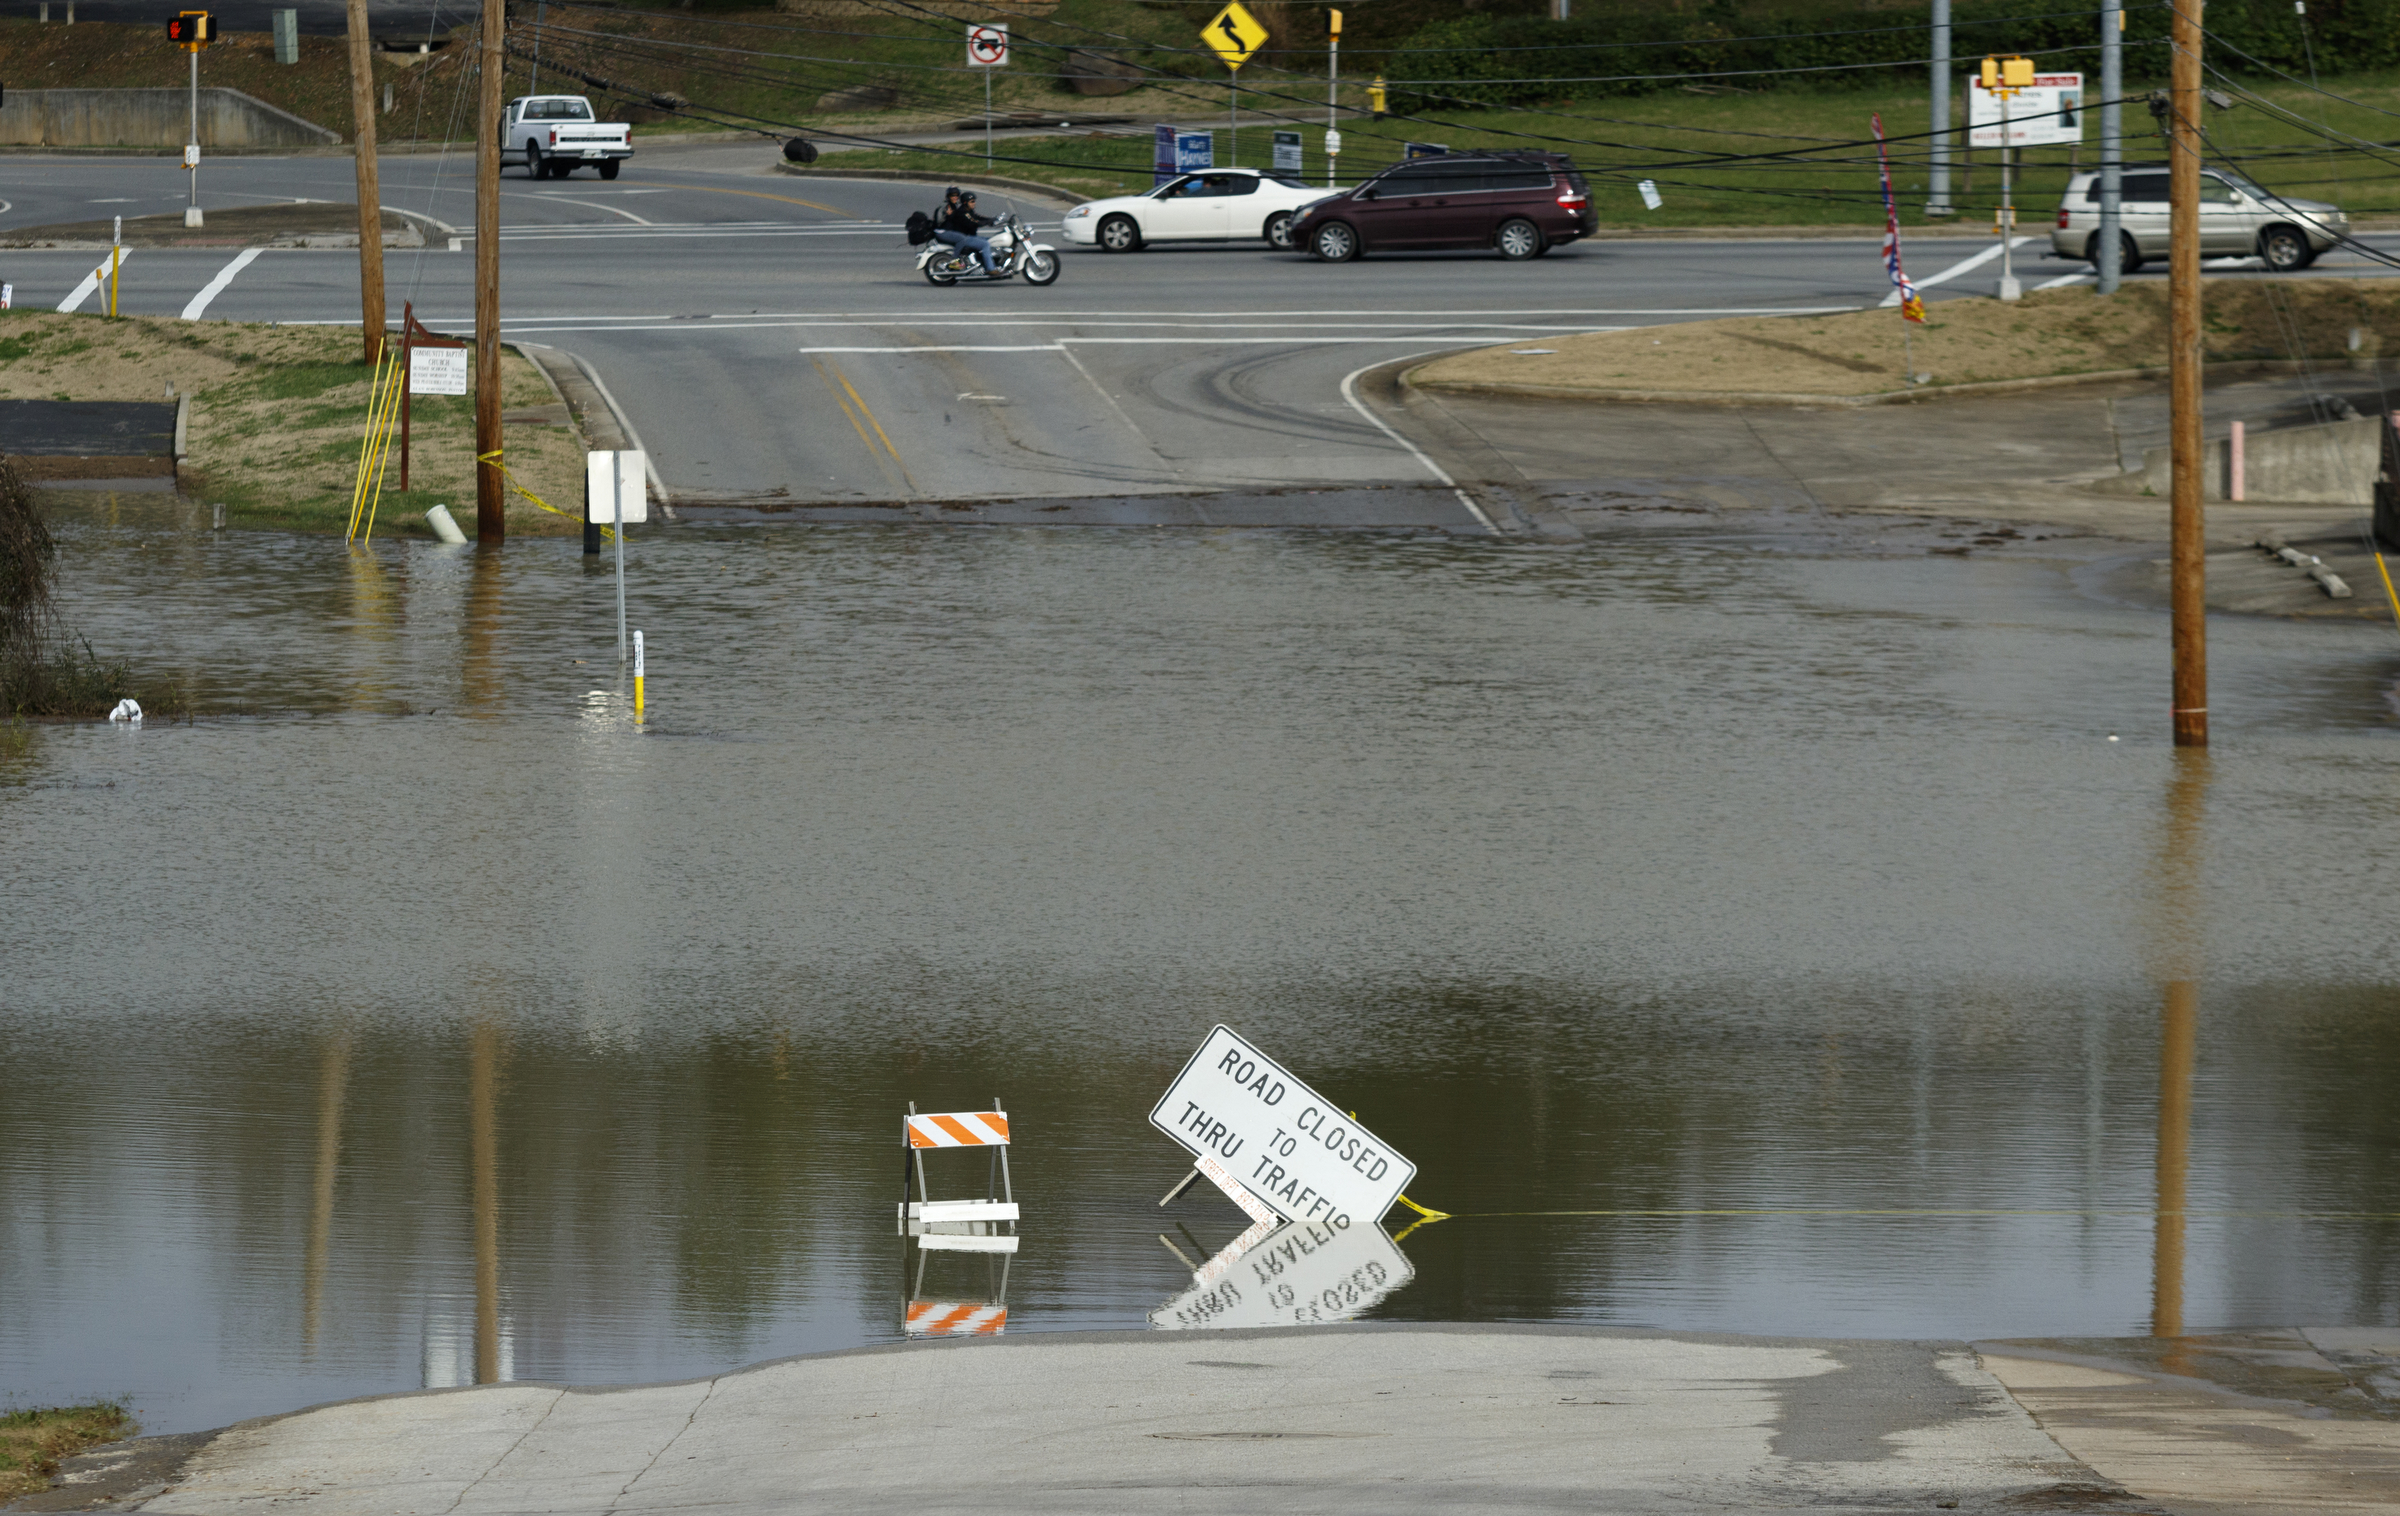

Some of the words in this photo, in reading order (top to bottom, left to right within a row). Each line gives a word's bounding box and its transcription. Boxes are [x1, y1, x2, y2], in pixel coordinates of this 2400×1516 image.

[413, 350, 444, 358] COMMUNITY
[1178, 1100, 1244, 1158] THRU
[1218, 1048, 1285, 1106] ROAD
[1297, 1106, 1389, 1182] CLOSED
[1269, 1127, 1297, 1157] TO
[1200, 1158, 1225, 1182] STREET
[1219, 1175, 1240, 1196] DEPT
